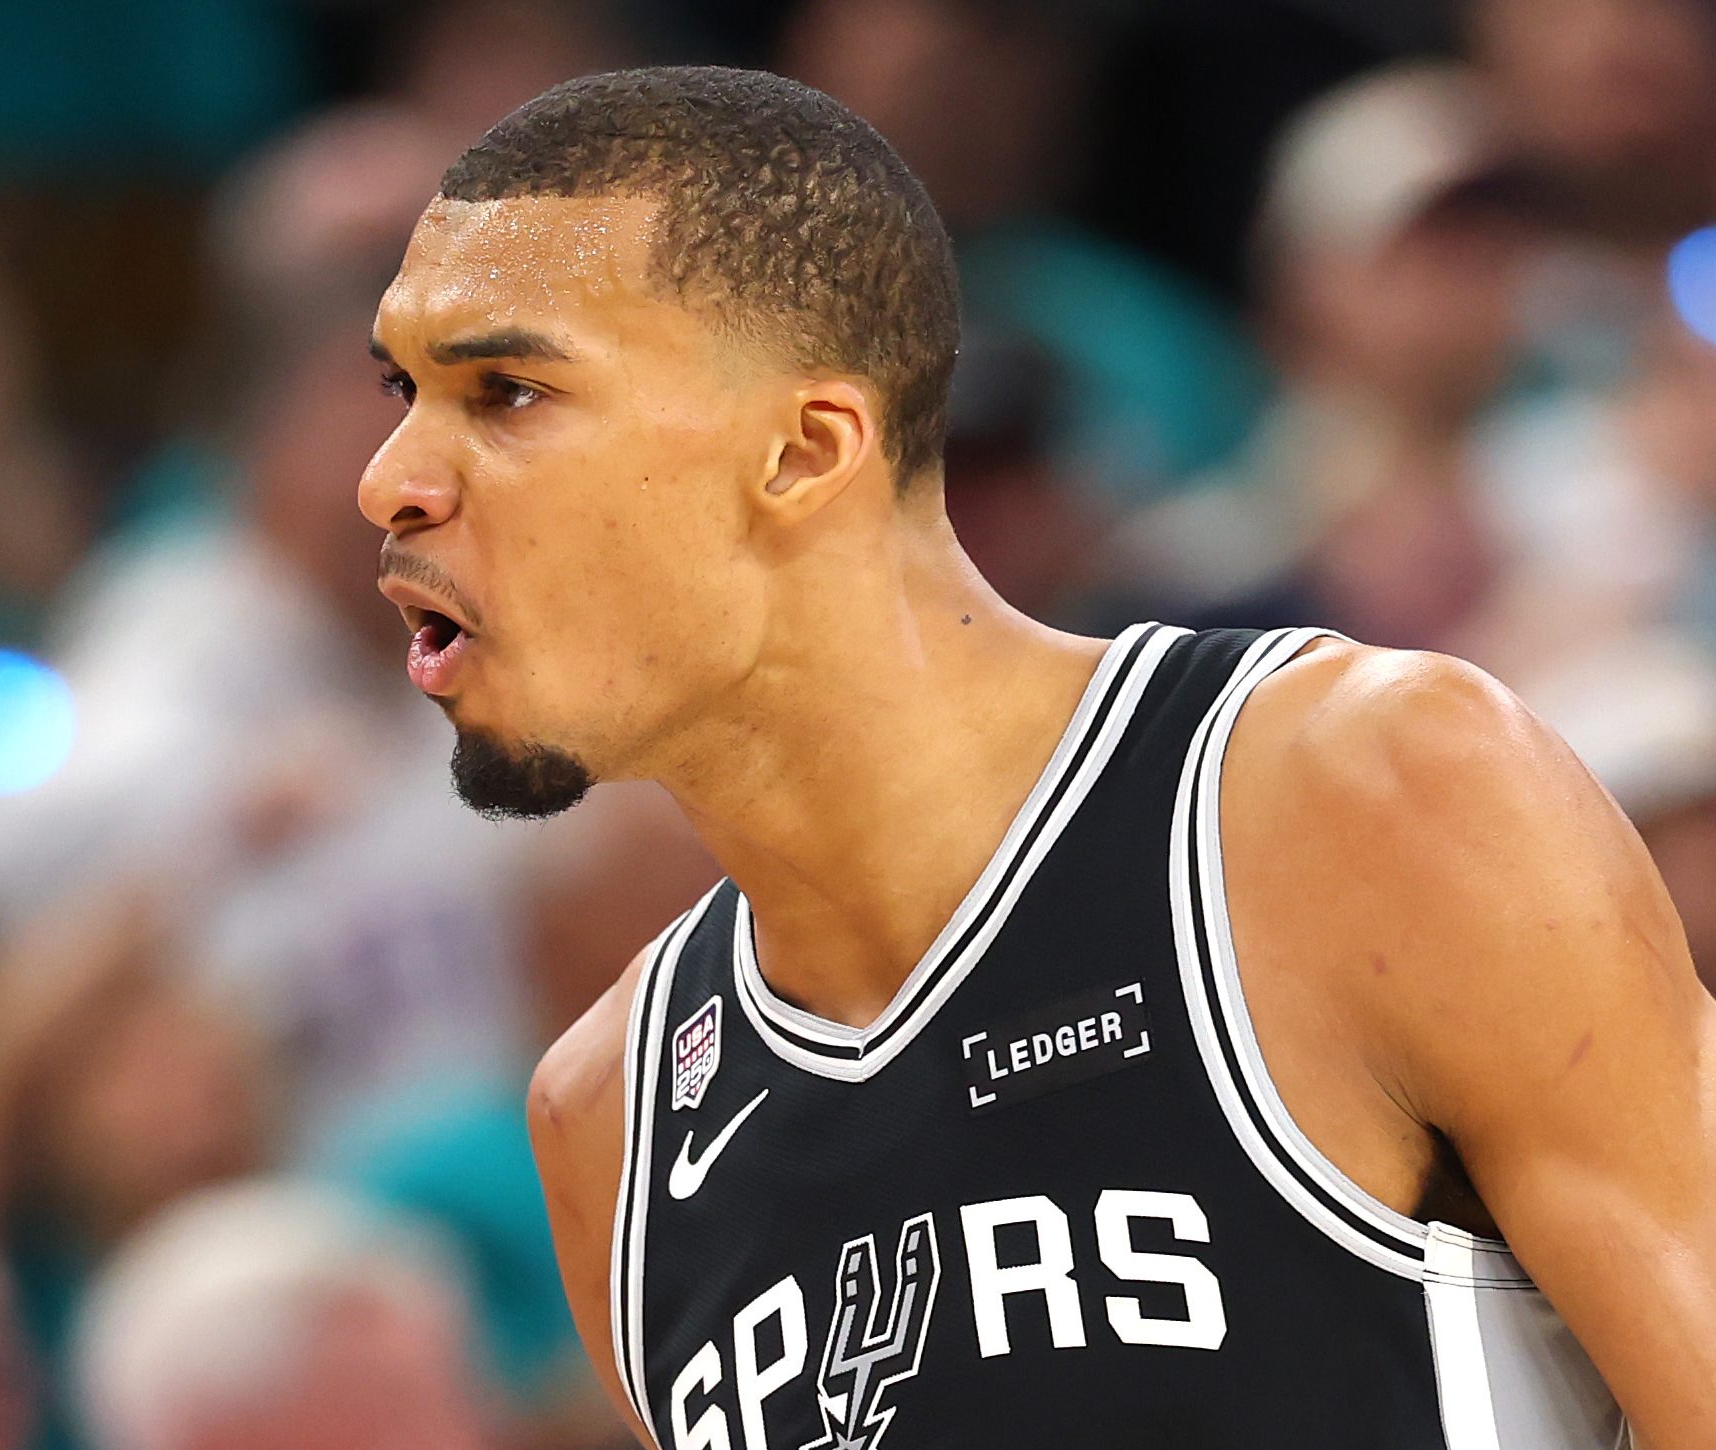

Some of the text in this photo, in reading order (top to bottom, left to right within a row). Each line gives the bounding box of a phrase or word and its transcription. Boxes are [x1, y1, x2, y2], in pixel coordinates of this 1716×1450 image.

[678, 1013, 715, 1059] USA
[987, 1011, 1124, 1080] LEDGER
[676, 1045, 714, 1101] 250
